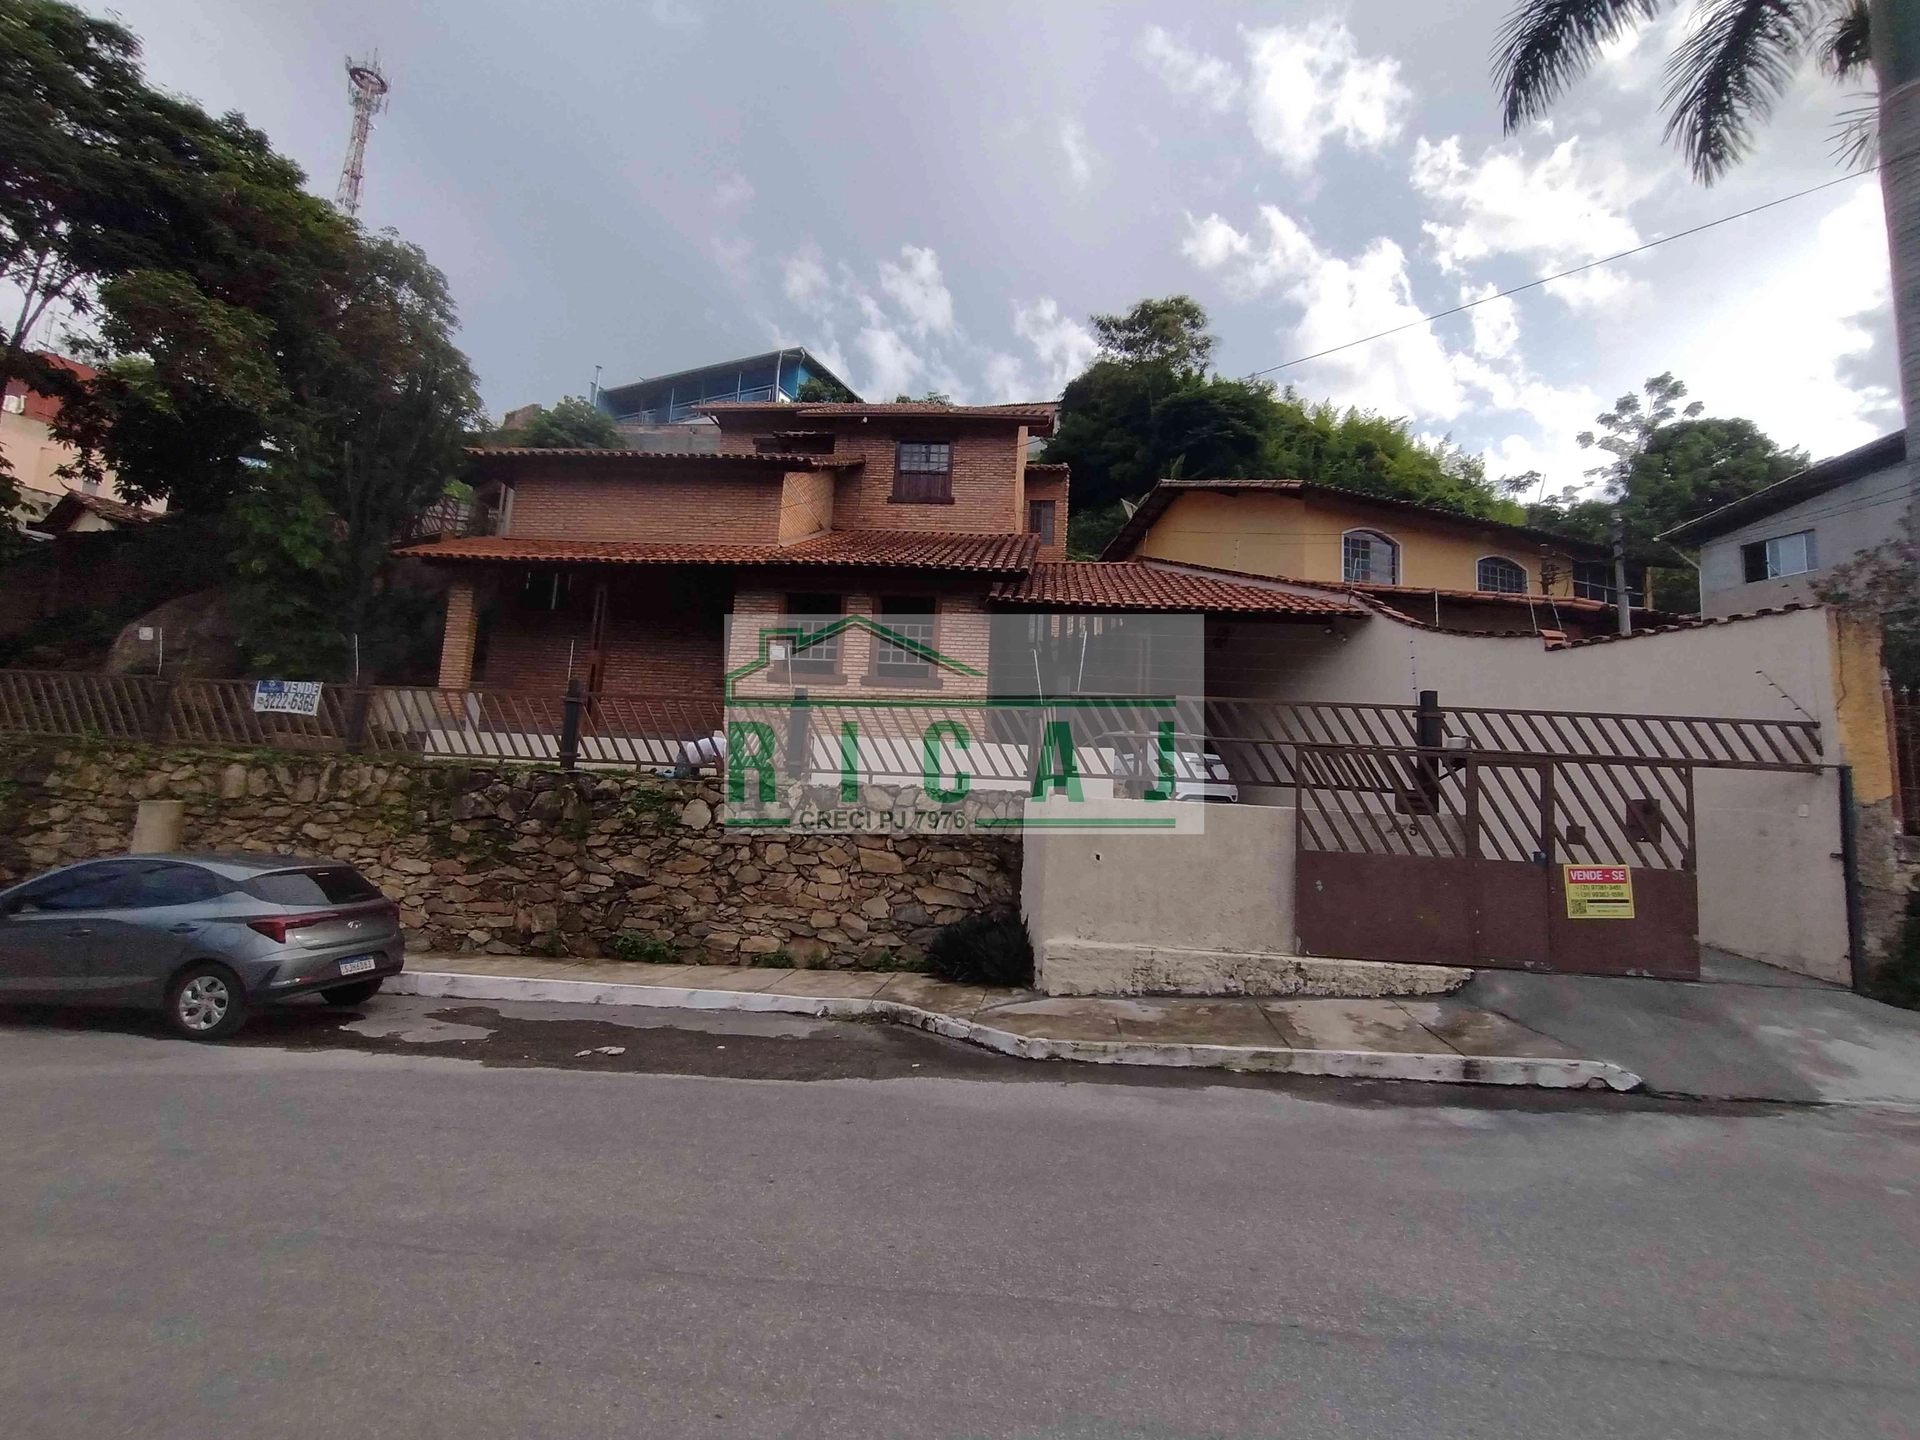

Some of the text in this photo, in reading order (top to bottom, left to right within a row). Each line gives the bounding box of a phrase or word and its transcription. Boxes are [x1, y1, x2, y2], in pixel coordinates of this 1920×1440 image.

[284, 682, 320, 694] VENDE
[264, 691, 315, 711] 3222-6369
[1570, 870, 1604, 881] VENDE
[1611, 870, 1625, 881] SE
